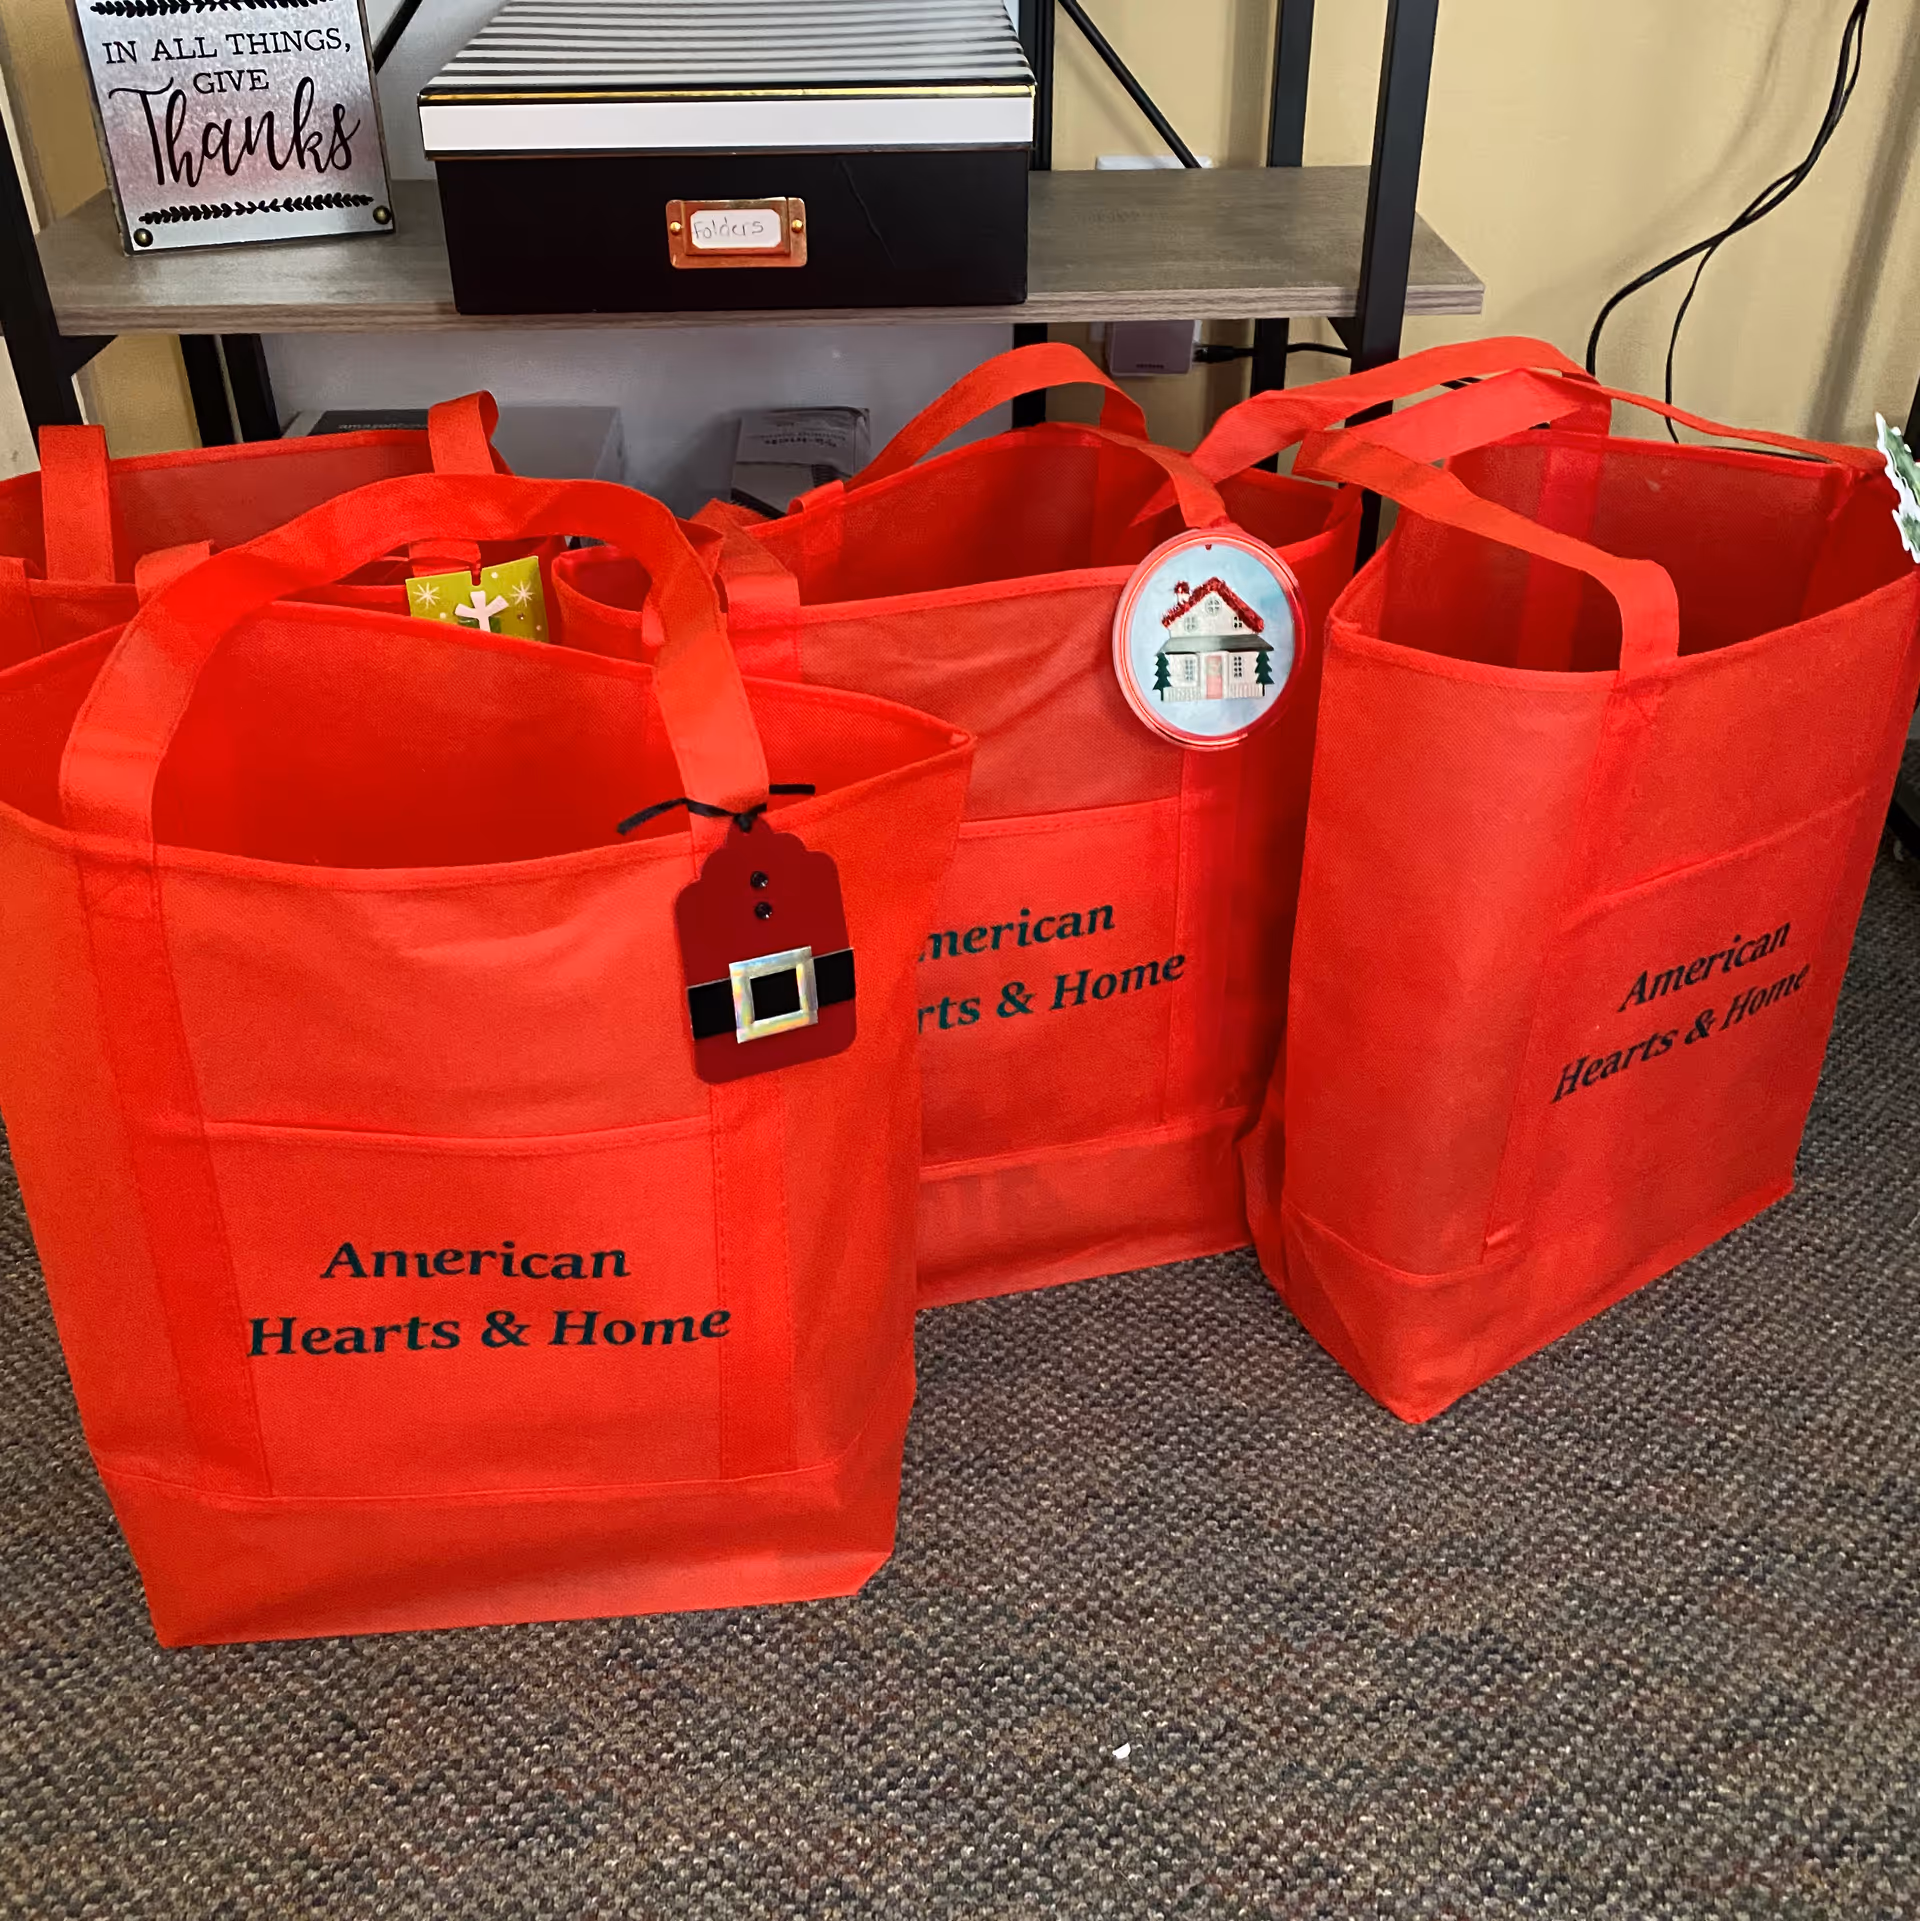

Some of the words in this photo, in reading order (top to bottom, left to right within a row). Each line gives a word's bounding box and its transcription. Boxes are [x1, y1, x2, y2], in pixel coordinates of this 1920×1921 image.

[102, 40, 137, 64] IN
[151, 36, 217, 62] ALL
[225, 27, 351, 56] THINGS,
[193, 69, 269, 95] GIVE
[108, 76, 361, 188] Thanks
[693, 216, 764, 240] Folders
[917, 904, 1115, 962] merican
[917, 996, 981, 1034] rts
[996, 981, 1035, 1019] &
[1049, 954, 1186, 1011] Home
[1617, 922, 1791, 1013] American
[1551, 1029, 1679, 1105] Hearts
[1684, 1008, 1716, 1044] &
[1719, 963, 1811, 1032] Home
[320, 1240, 631, 1280] American
[246, 1316, 460, 1357] Hearts
[481, 1310, 530, 1348] &
[548, 1308, 732, 1347] Home
